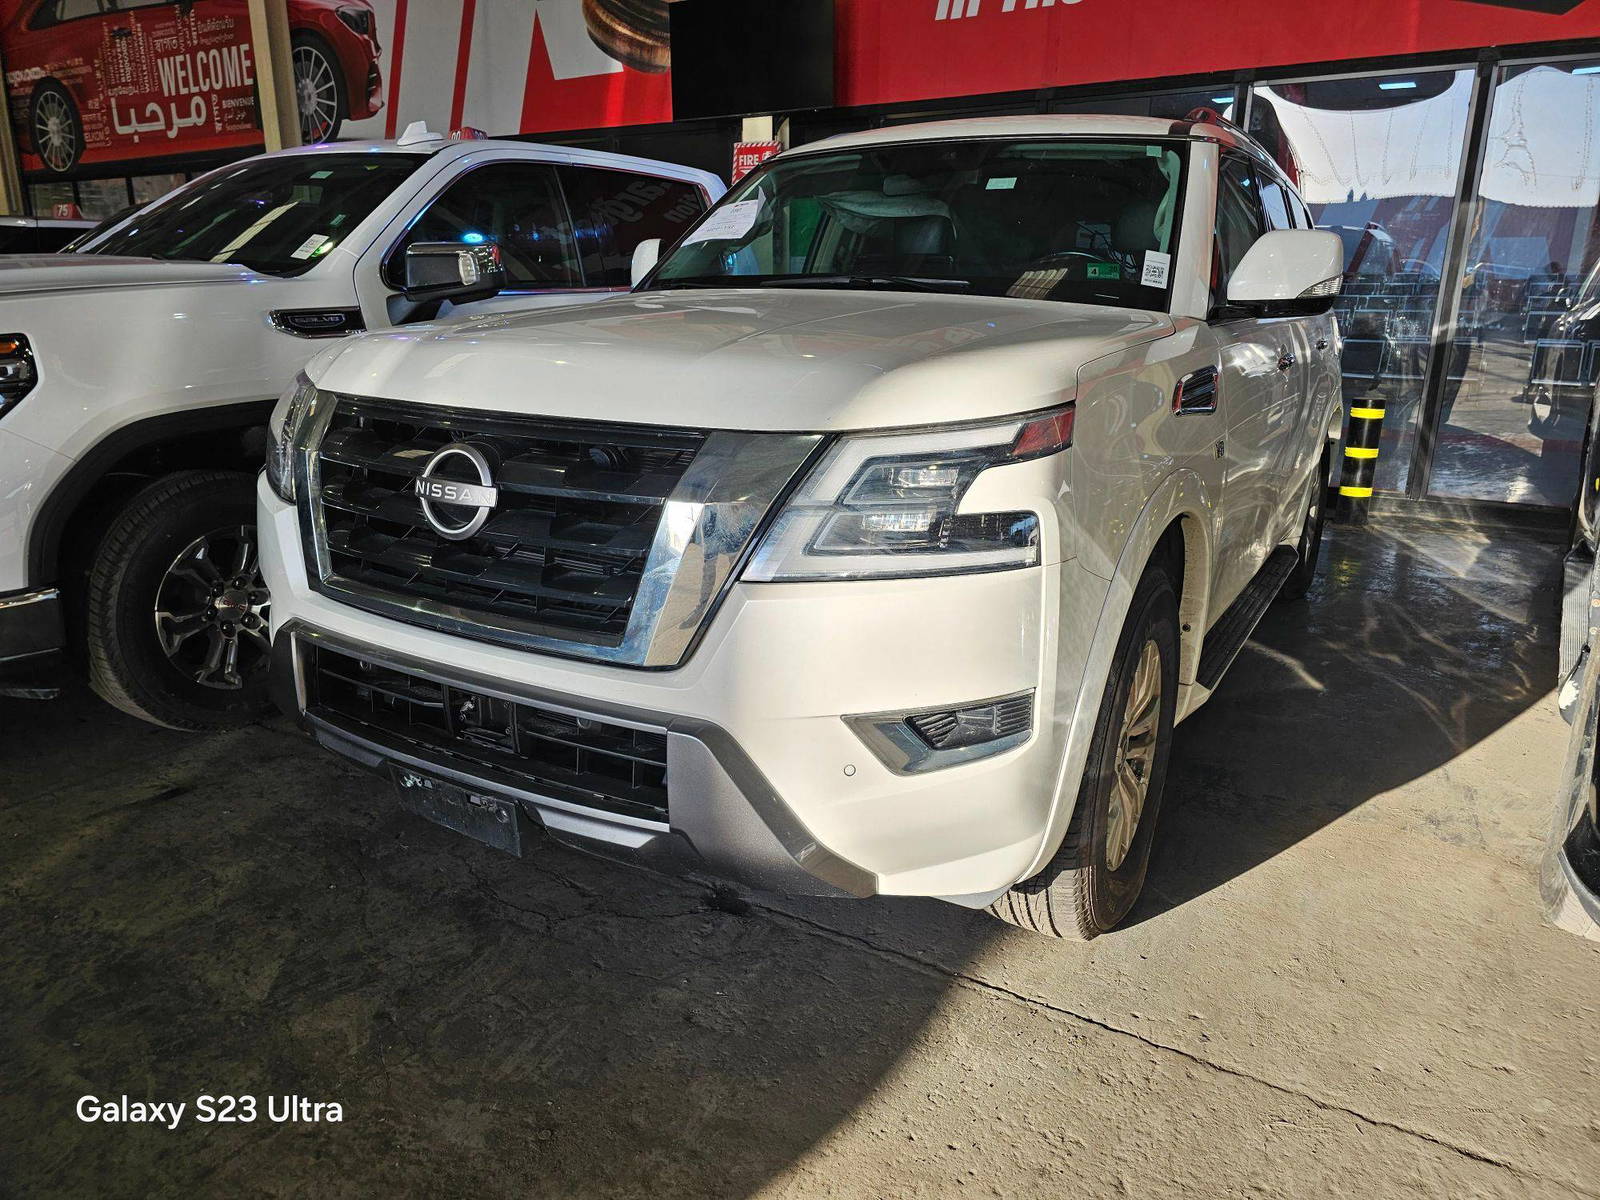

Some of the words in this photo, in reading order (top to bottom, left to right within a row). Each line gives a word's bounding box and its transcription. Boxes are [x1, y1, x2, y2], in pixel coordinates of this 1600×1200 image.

[157, 43, 254, 97] WELCOME
[110, 95, 207, 143] مرحبا
[738, 154, 759, 166] FIRE
[57, 204, 69, 217] 75
[415, 479, 493, 505] NISSAN
